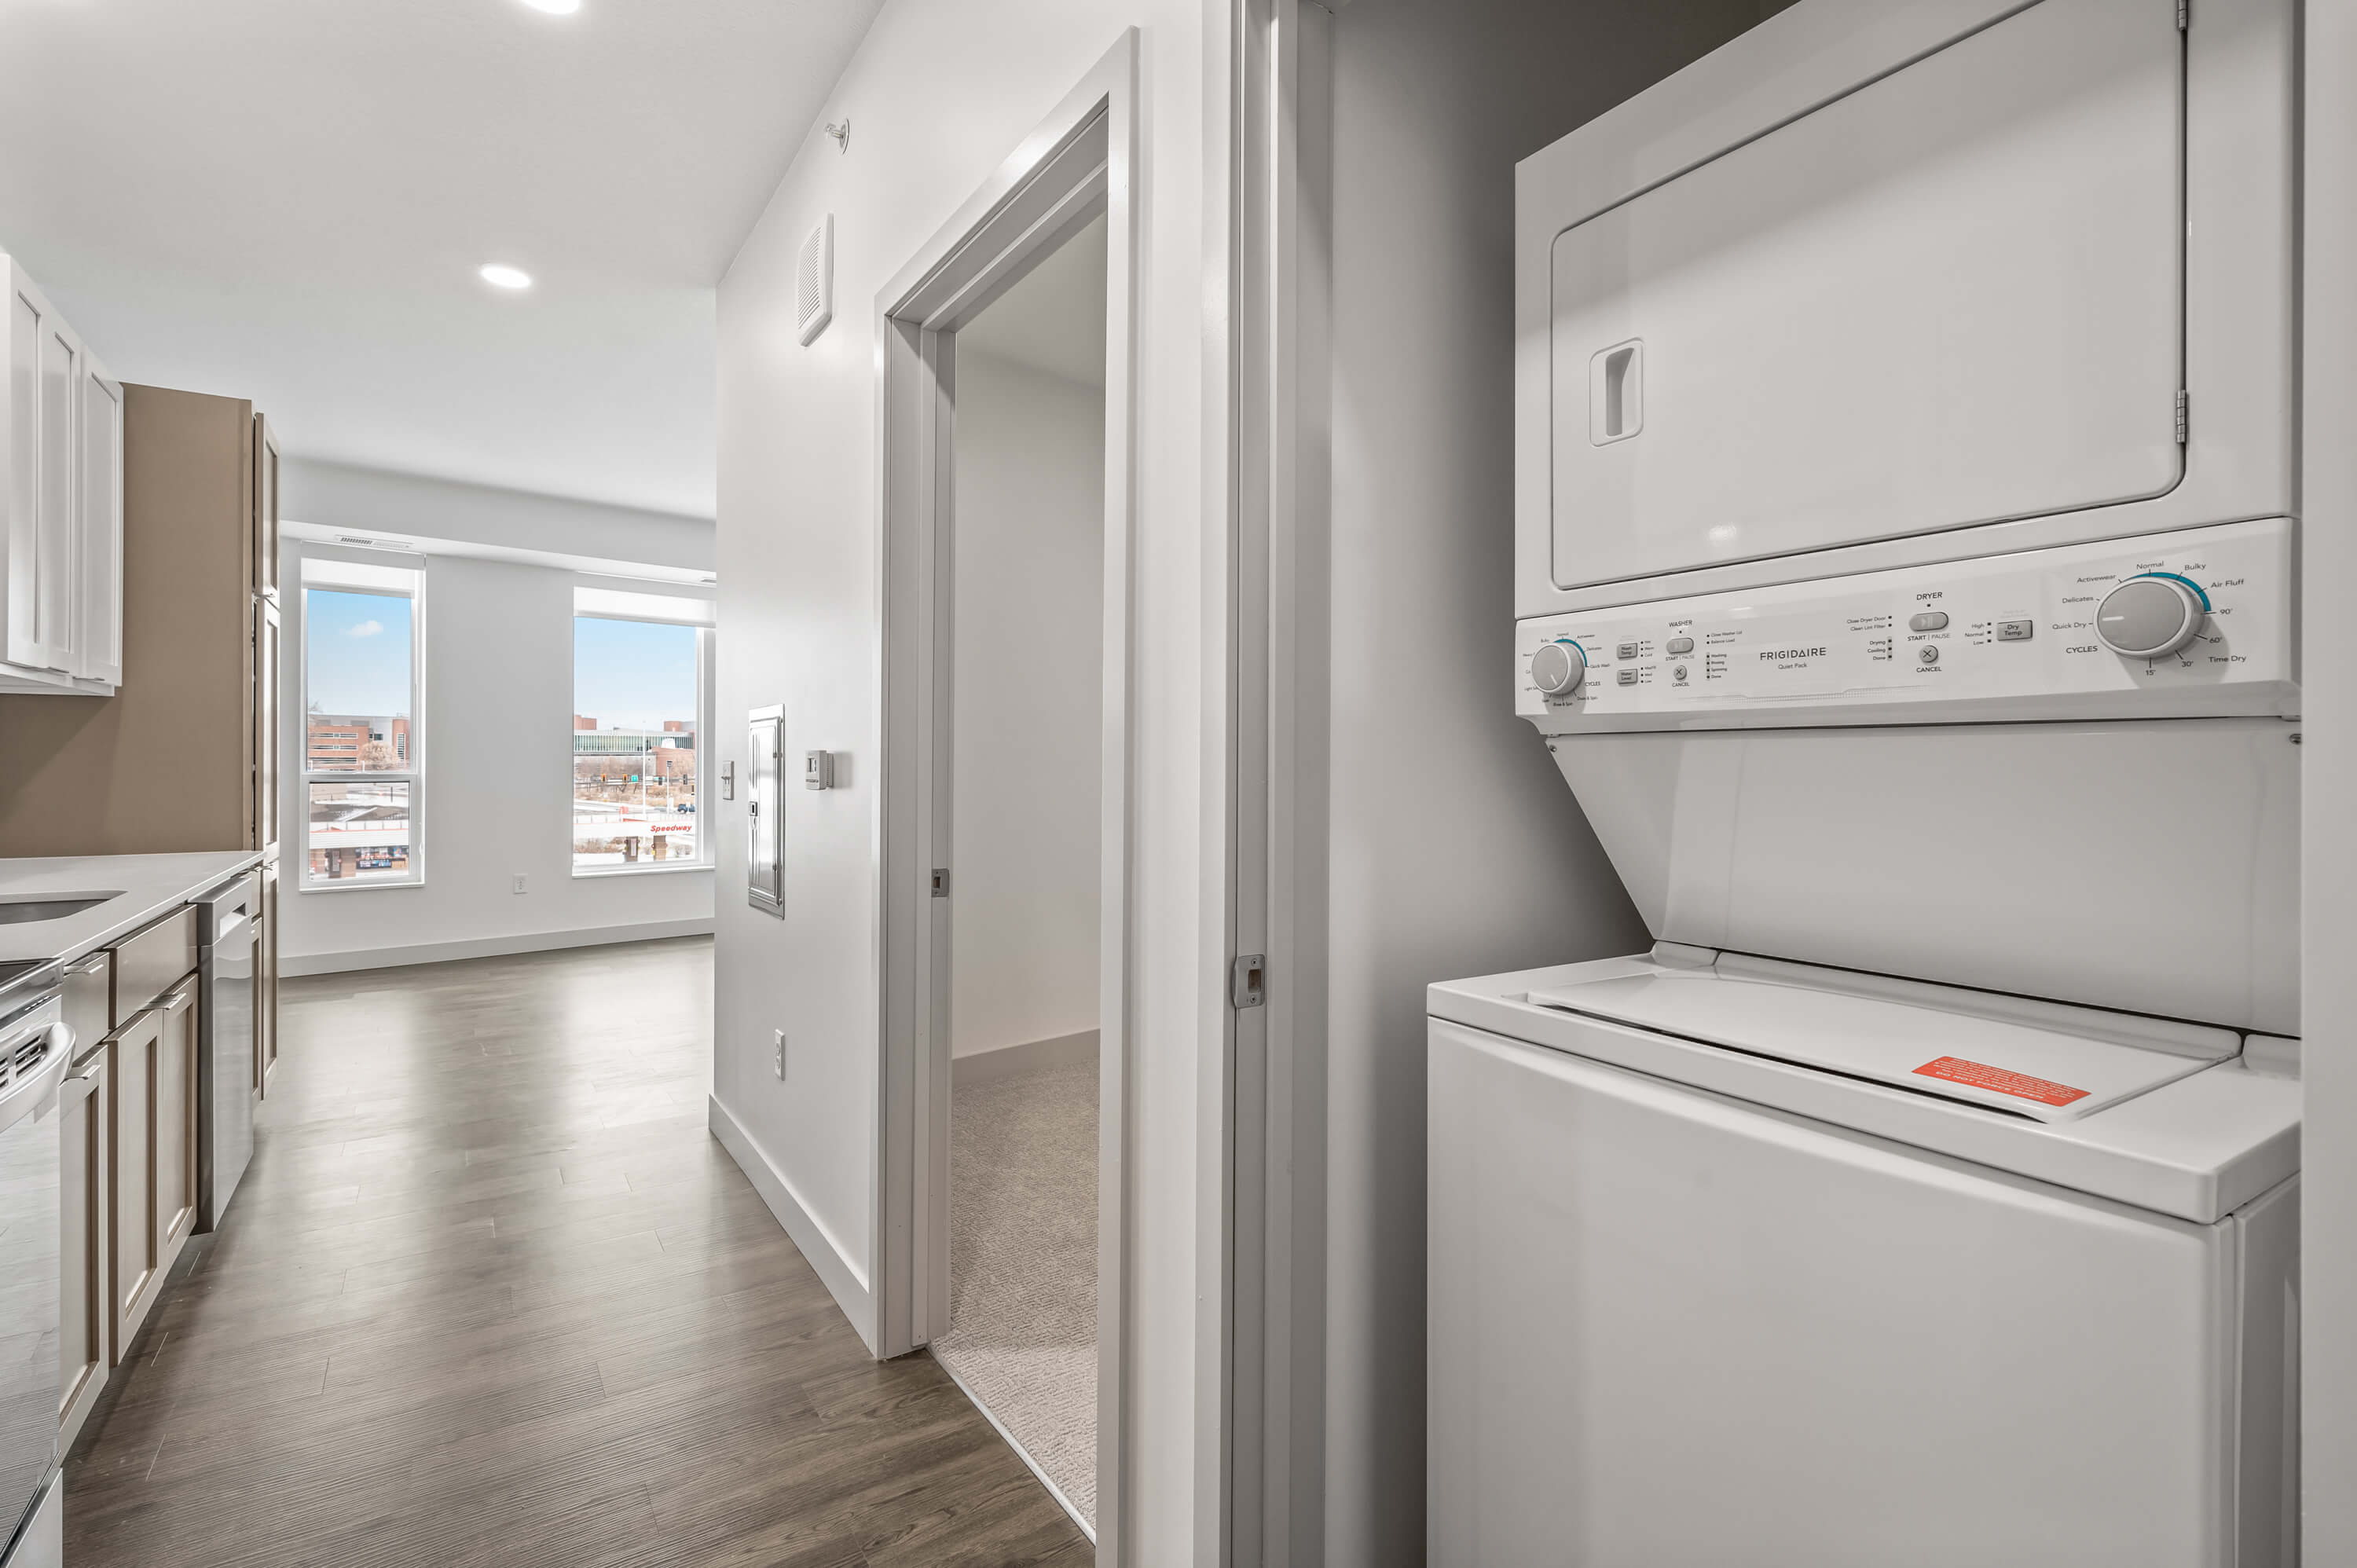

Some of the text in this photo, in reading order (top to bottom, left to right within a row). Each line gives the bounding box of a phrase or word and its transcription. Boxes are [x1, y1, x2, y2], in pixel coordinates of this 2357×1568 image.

[2136, 561, 2164, 570] Normal
[2184, 562, 2206, 571] Bulky
[2077, 574, 2117, 584] Activewear
[1916, 592, 1943, 600] DRYER
[2062, 595, 2094, 604] Delicates
[1760, 647, 1827, 661] FRIGIDAIRE
